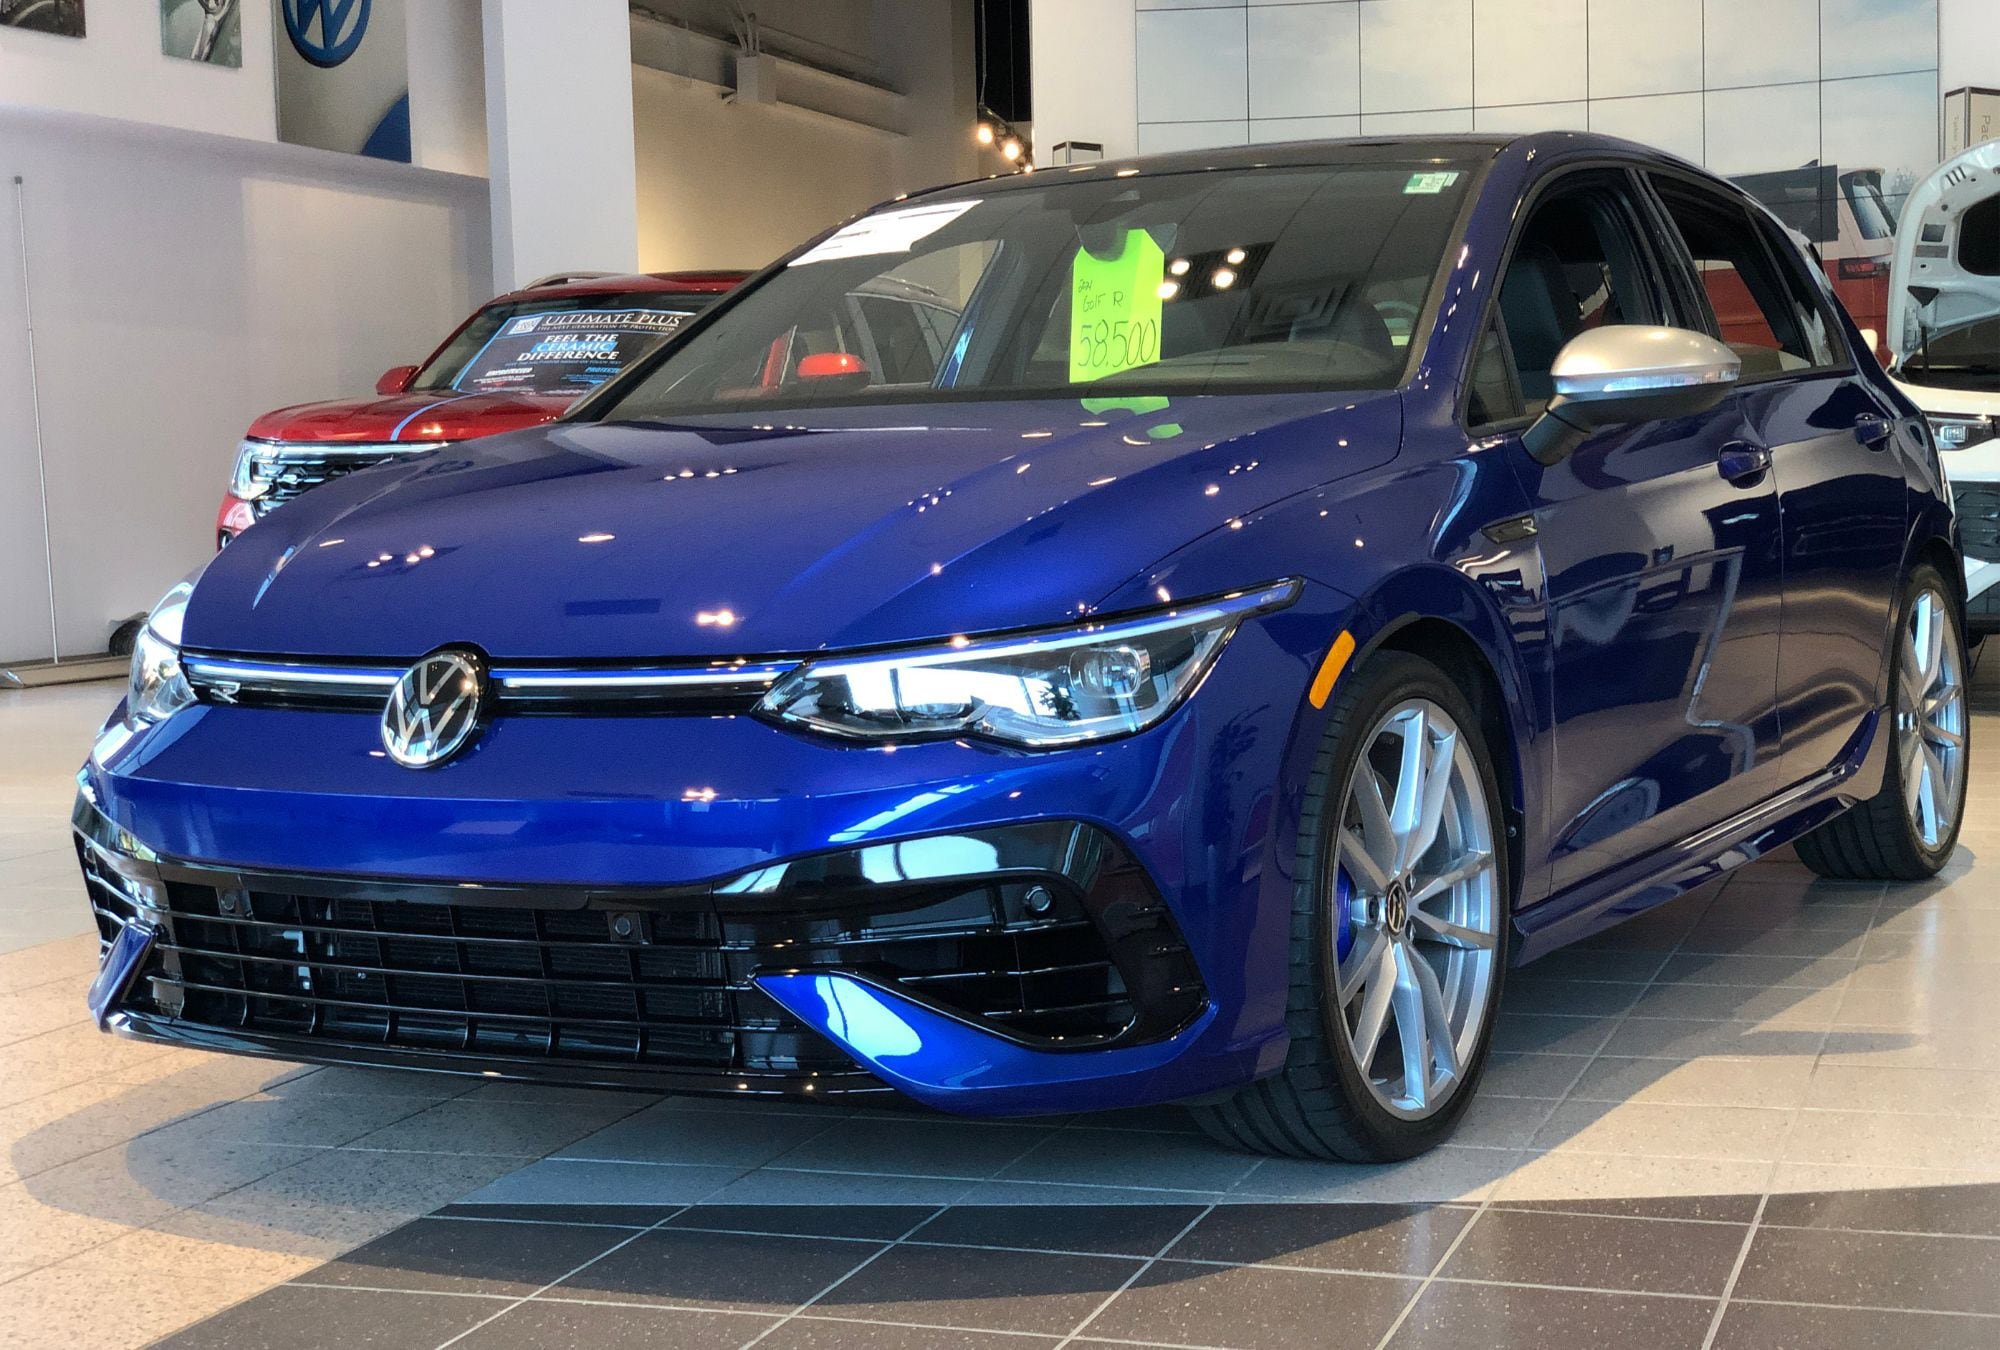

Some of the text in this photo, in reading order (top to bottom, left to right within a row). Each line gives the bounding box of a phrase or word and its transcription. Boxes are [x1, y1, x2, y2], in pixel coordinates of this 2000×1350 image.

[1113, 290, 1124, 307] R
[546, 313, 635, 326] ULTIMATE
[635, 313, 683, 326] PLUS
[630, 324, 677, 332] PROTECTION
[544, 334, 619, 343] FEEL THE
[536, 342, 614, 351] CERAMIC
[517, 351, 620, 361] DIFFERENCE
[1522, 518, 1538, 534] R
[210, 680, 241, 704] R
